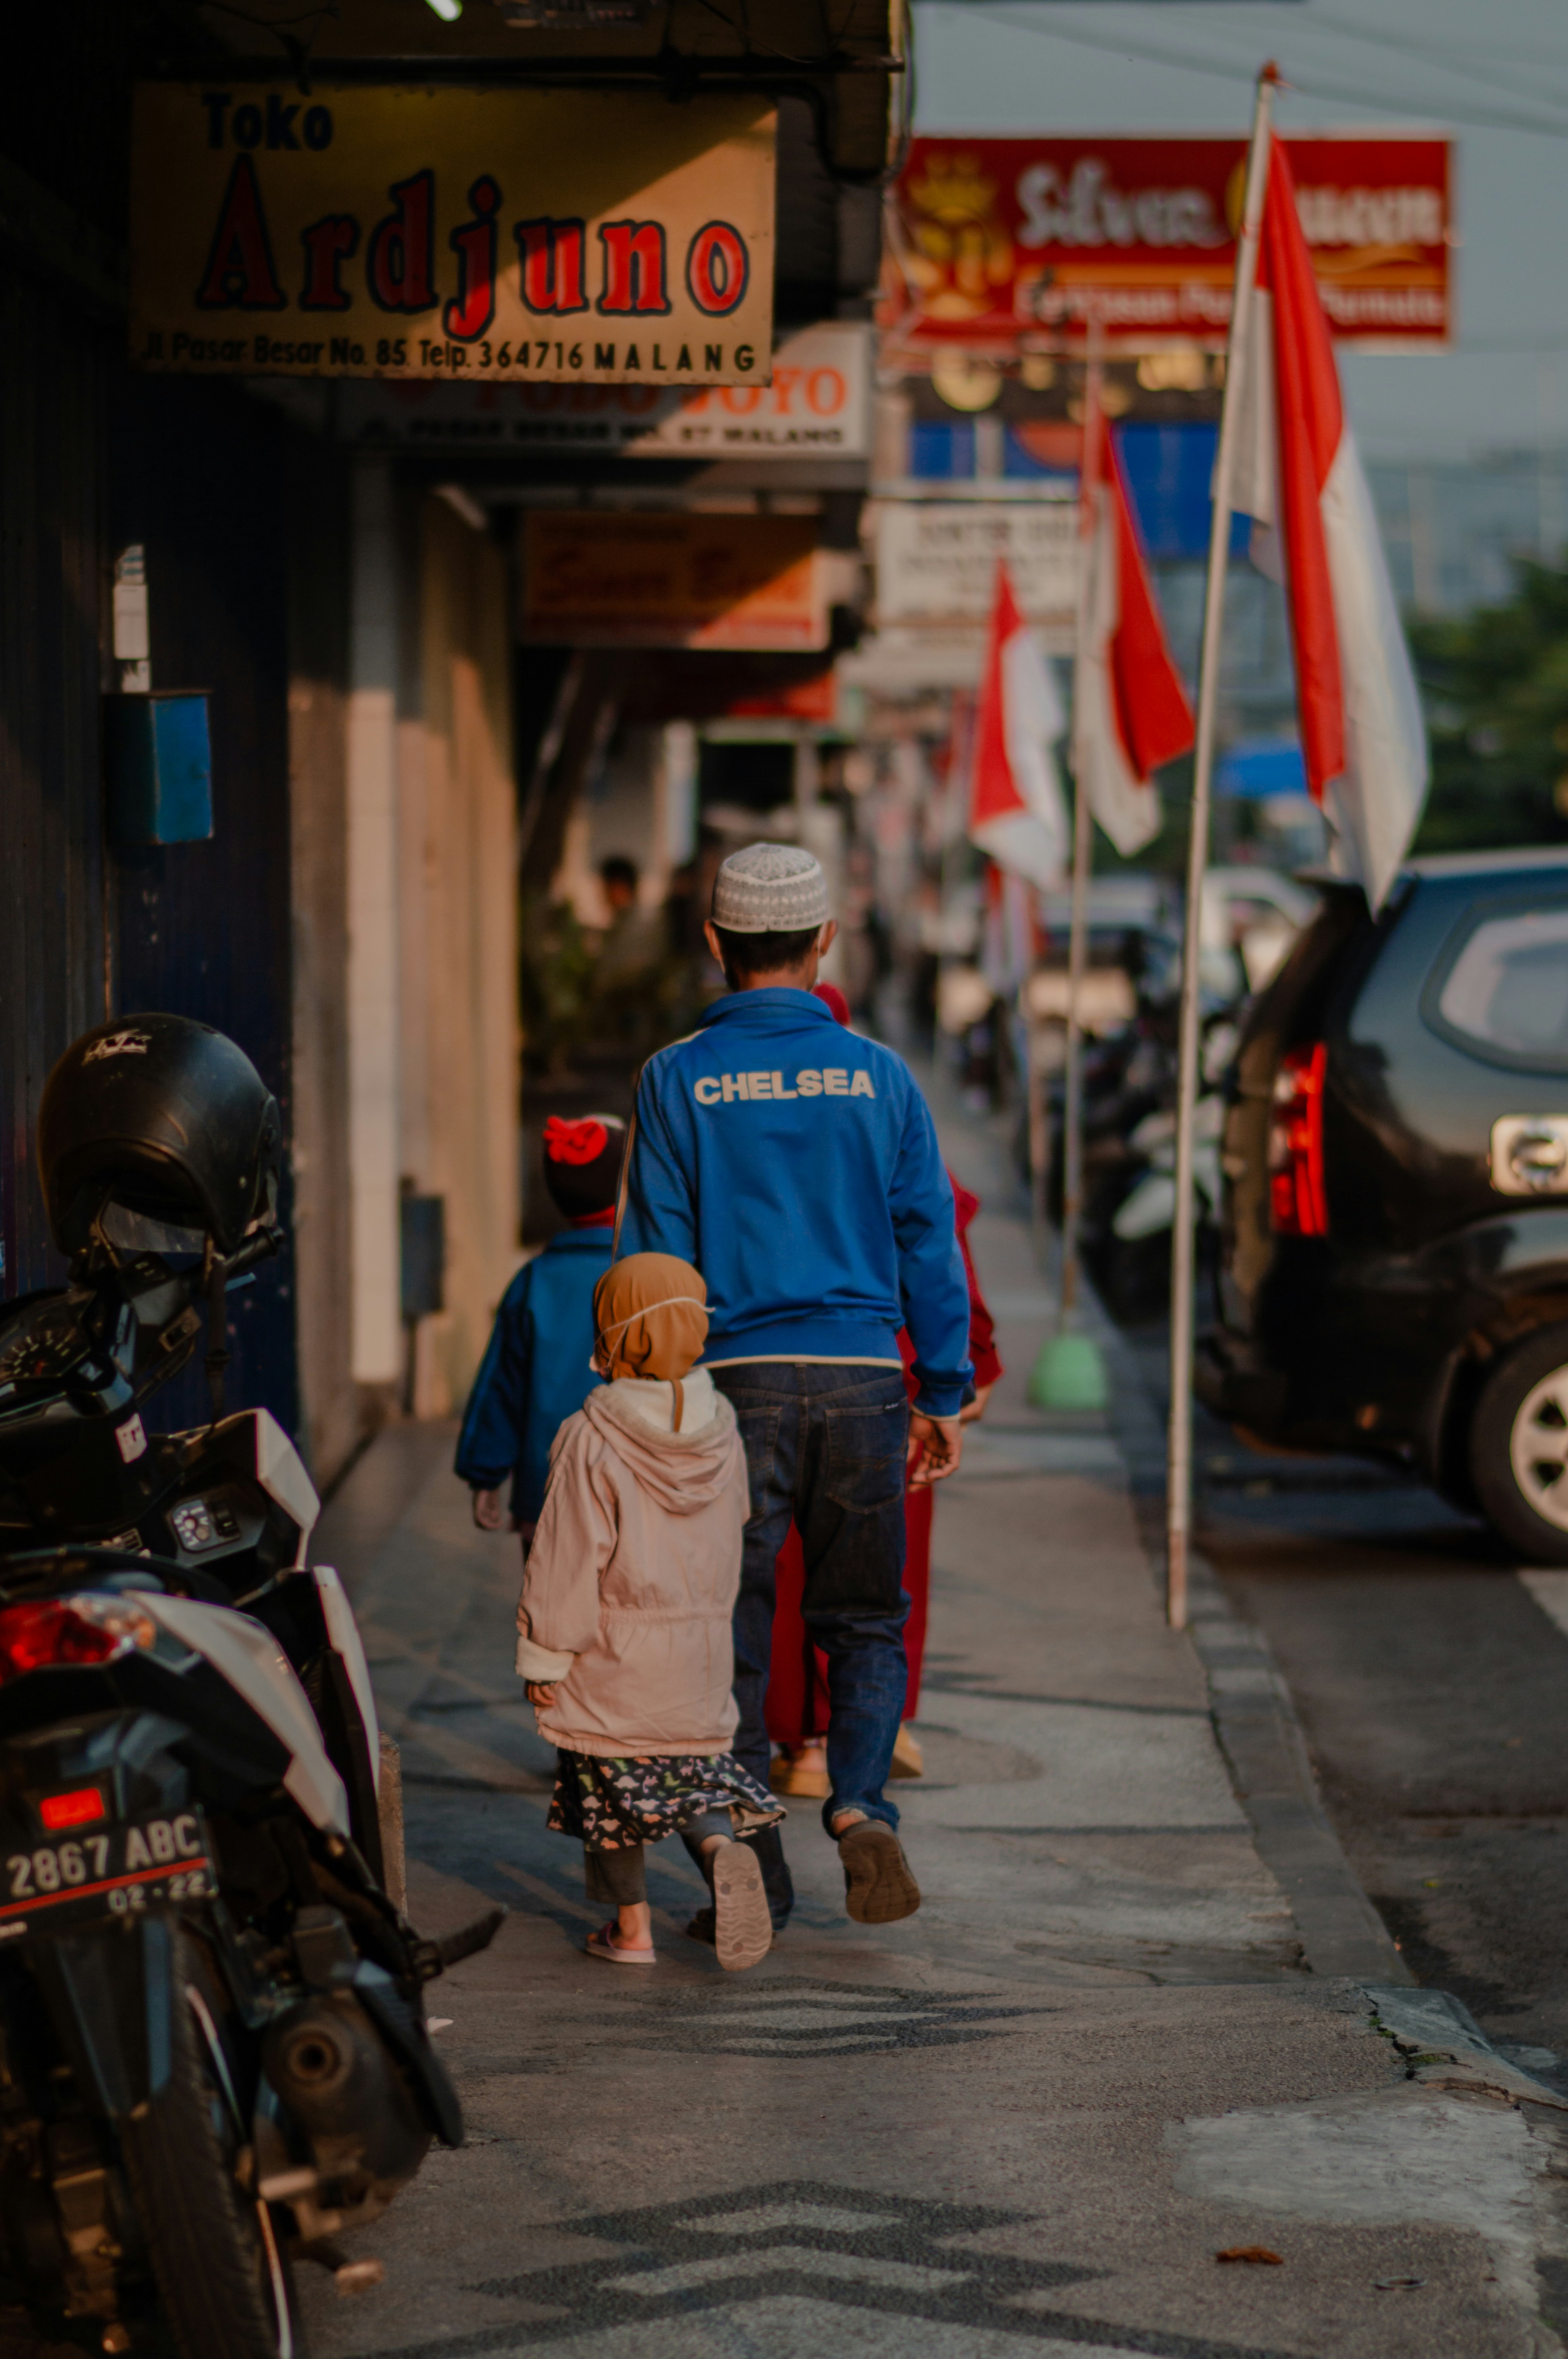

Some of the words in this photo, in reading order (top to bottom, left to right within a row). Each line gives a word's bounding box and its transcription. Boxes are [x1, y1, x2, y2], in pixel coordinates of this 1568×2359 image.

[203, 92, 332, 151] Toko
[195, 152, 750, 342] Ardjuno
[172, 334, 246, 362] Pasar
[254, 336, 325, 364] Besar
[330, 337, 368, 366] No.
[419, 340, 471, 373] Telp.
[479, 340, 583, 370] 364716
[594, 342, 755, 372] MALANG
[694, 1067, 875, 1106] CHELSEA
[5, 1833, 110, 1899] 2867
[126, 1814, 201, 1872] ABC
